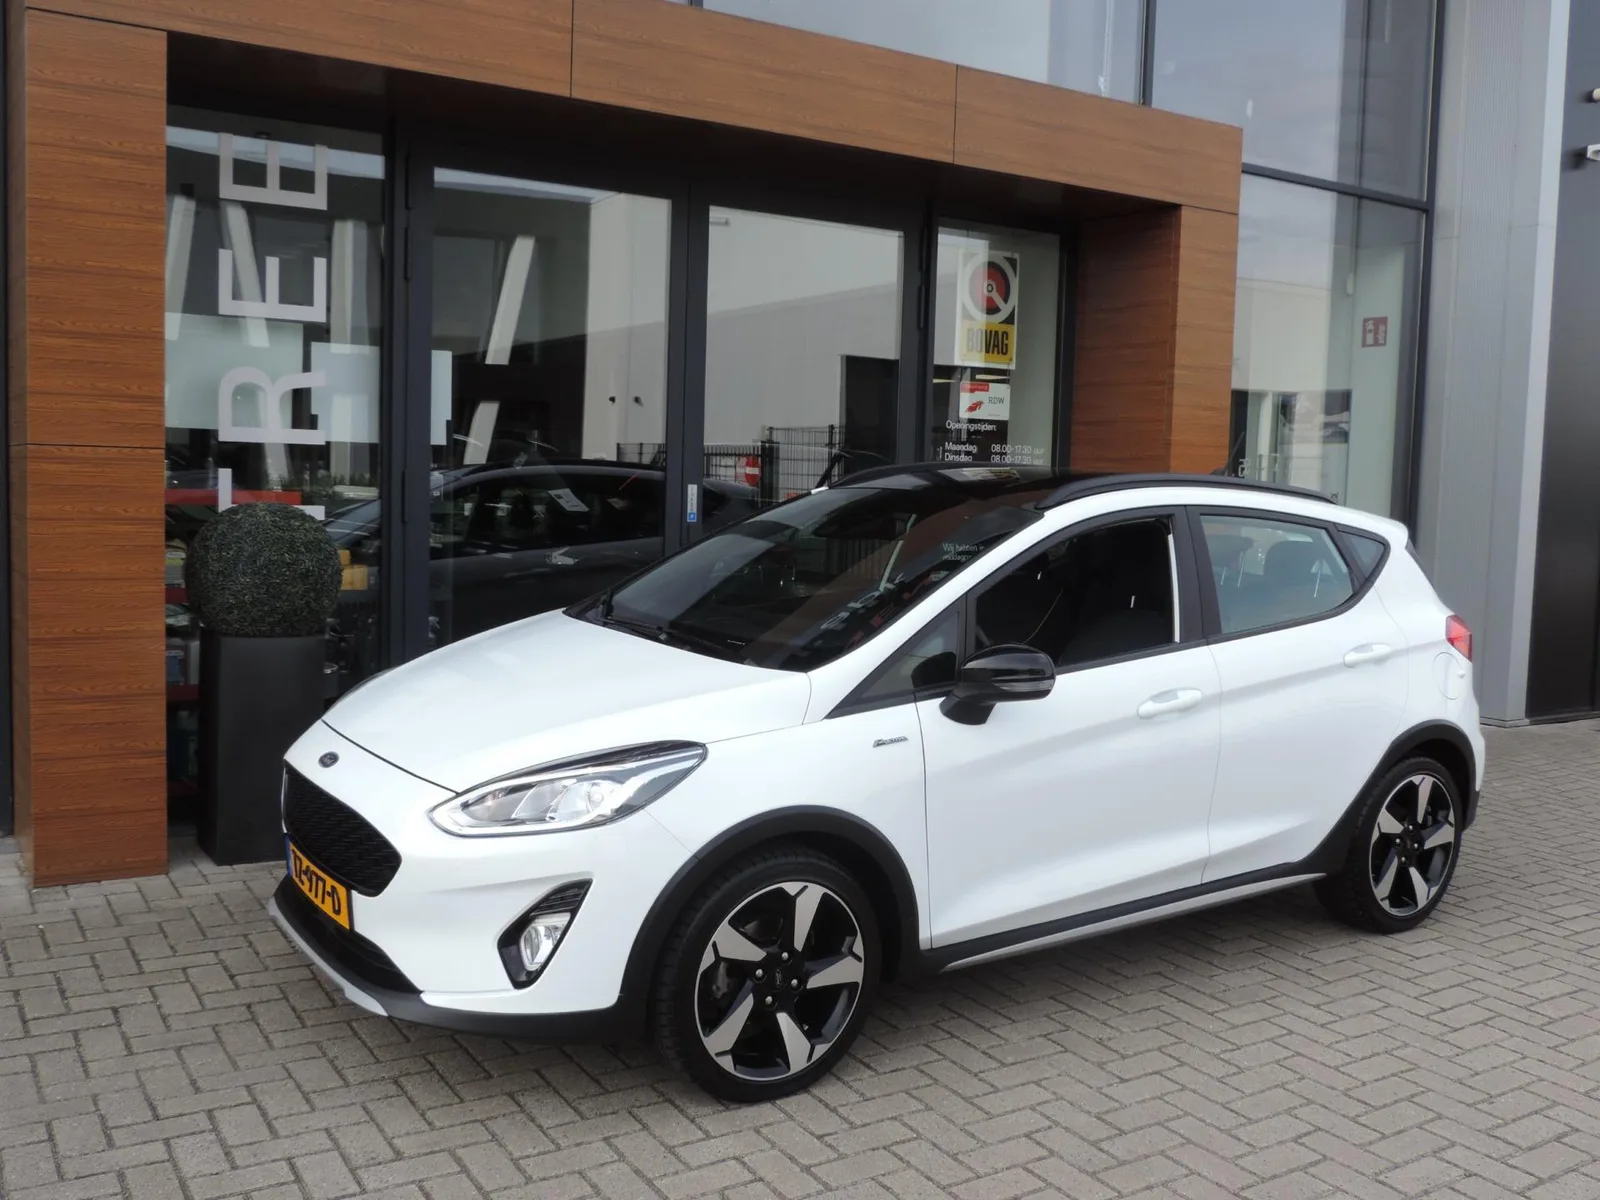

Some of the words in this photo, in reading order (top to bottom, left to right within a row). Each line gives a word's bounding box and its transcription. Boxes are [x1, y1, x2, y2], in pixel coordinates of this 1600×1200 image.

[966, 328, 1009, 356] BOVAG
[988, 396, 1005, 405] RDW
[945, 420, 997, 432] Openingstijden:
[944, 442, 978, 454] Maandag
[291, 848, 342, 916] TZ-977-D
